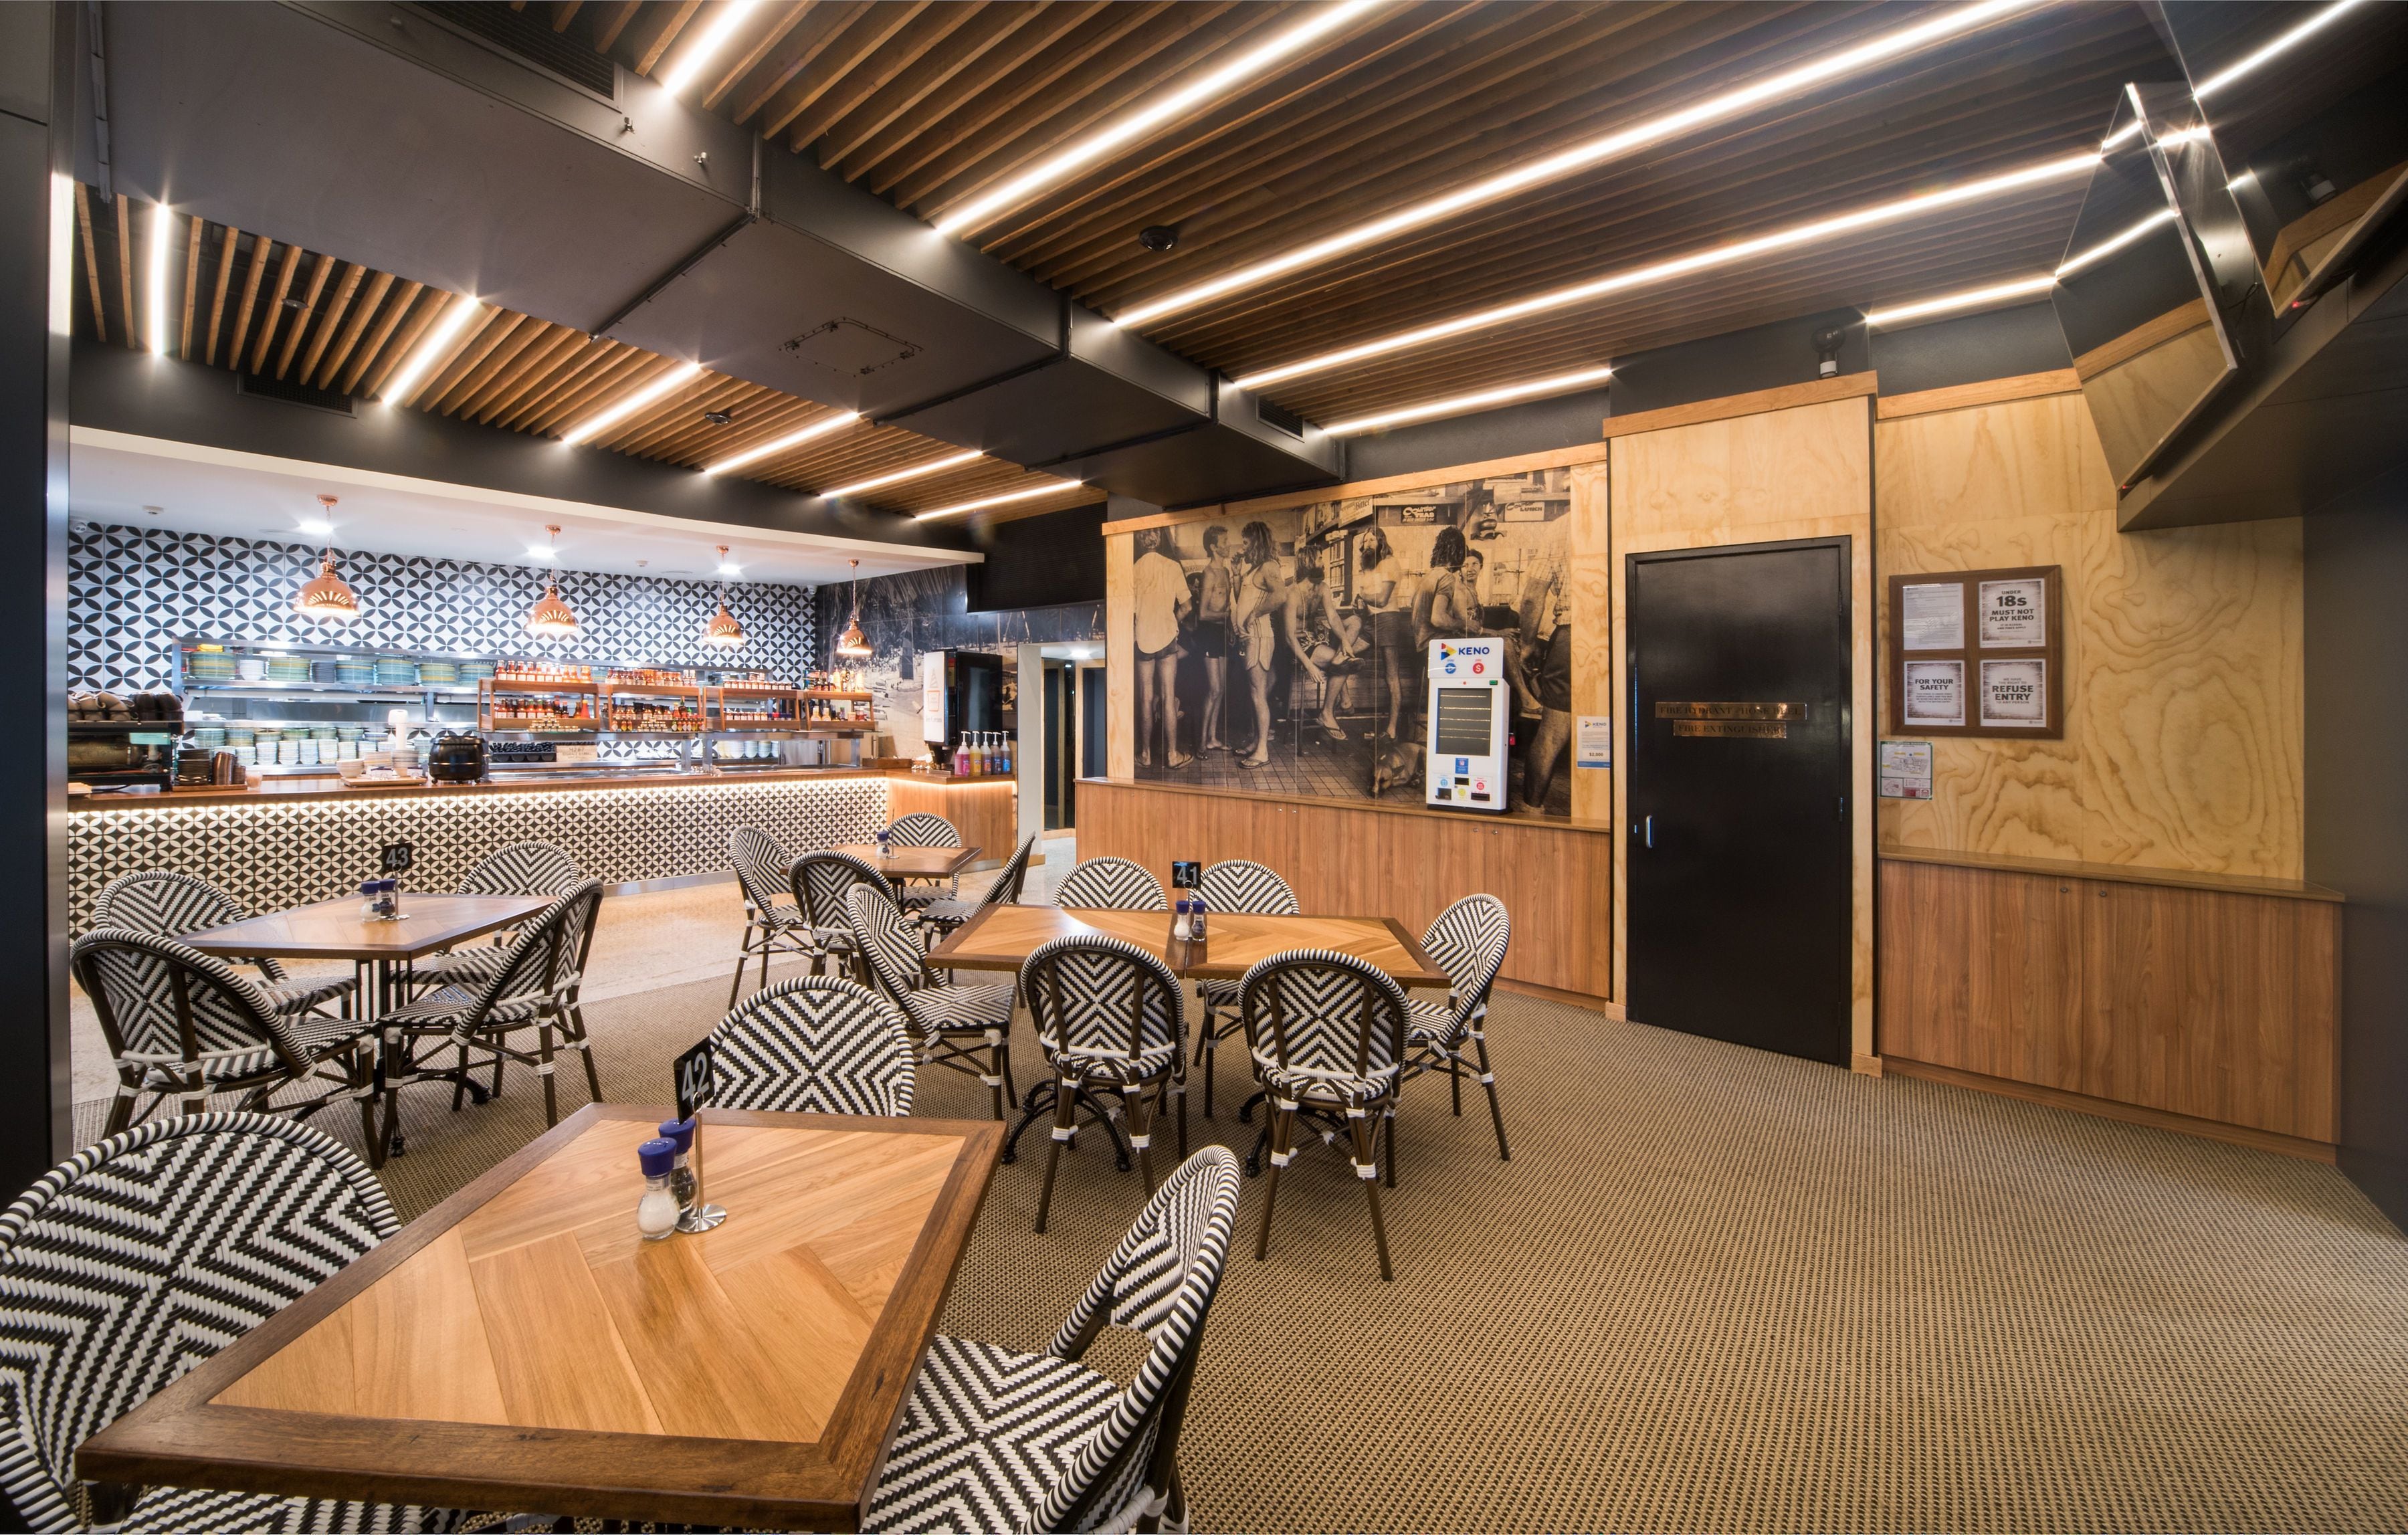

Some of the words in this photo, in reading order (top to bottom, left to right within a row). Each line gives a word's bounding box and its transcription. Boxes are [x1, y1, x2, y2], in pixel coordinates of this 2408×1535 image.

[1996, 595, 2027, 607] 18s
[1458, 647, 1490, 655] KENO
[1704, 726, 1782, 734] EXTINGUISHER
[386, 847, 409, 867] 43
[1177, 865, 1197, 885] 41
[682, 1051, 710, 1102] 42
